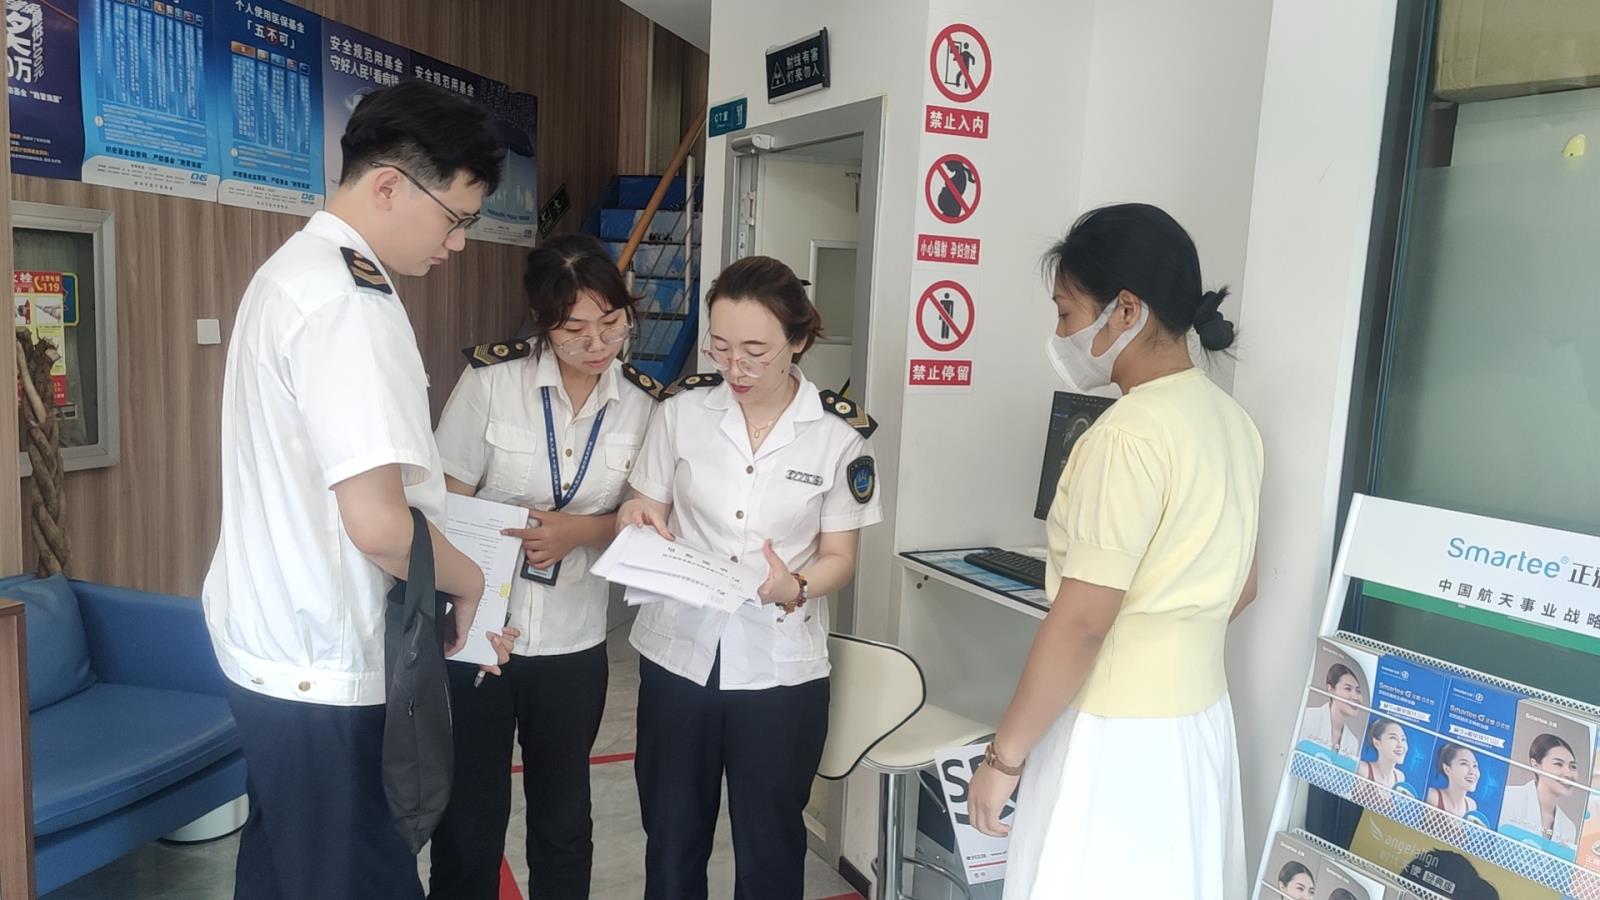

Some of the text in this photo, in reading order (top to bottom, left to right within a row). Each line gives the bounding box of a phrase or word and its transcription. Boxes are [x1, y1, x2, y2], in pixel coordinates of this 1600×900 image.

[329, 35, 404, 74] 安全规范用基金
[786, 47, 819, 70] 射线有害
[414, 65, 475, 98] 安全规范用基金
[787, 62, 820, 84] 灯亮勿入
[930, 111, 985, 134] 禁止入内
[919, 241, 977, 261] 小心辐射 孕妇勿进
[43, 283, 60, 292] 119
[912, 364, 971, 382] 禁止停留
[1384, 836, 1440, 868] angelalign
